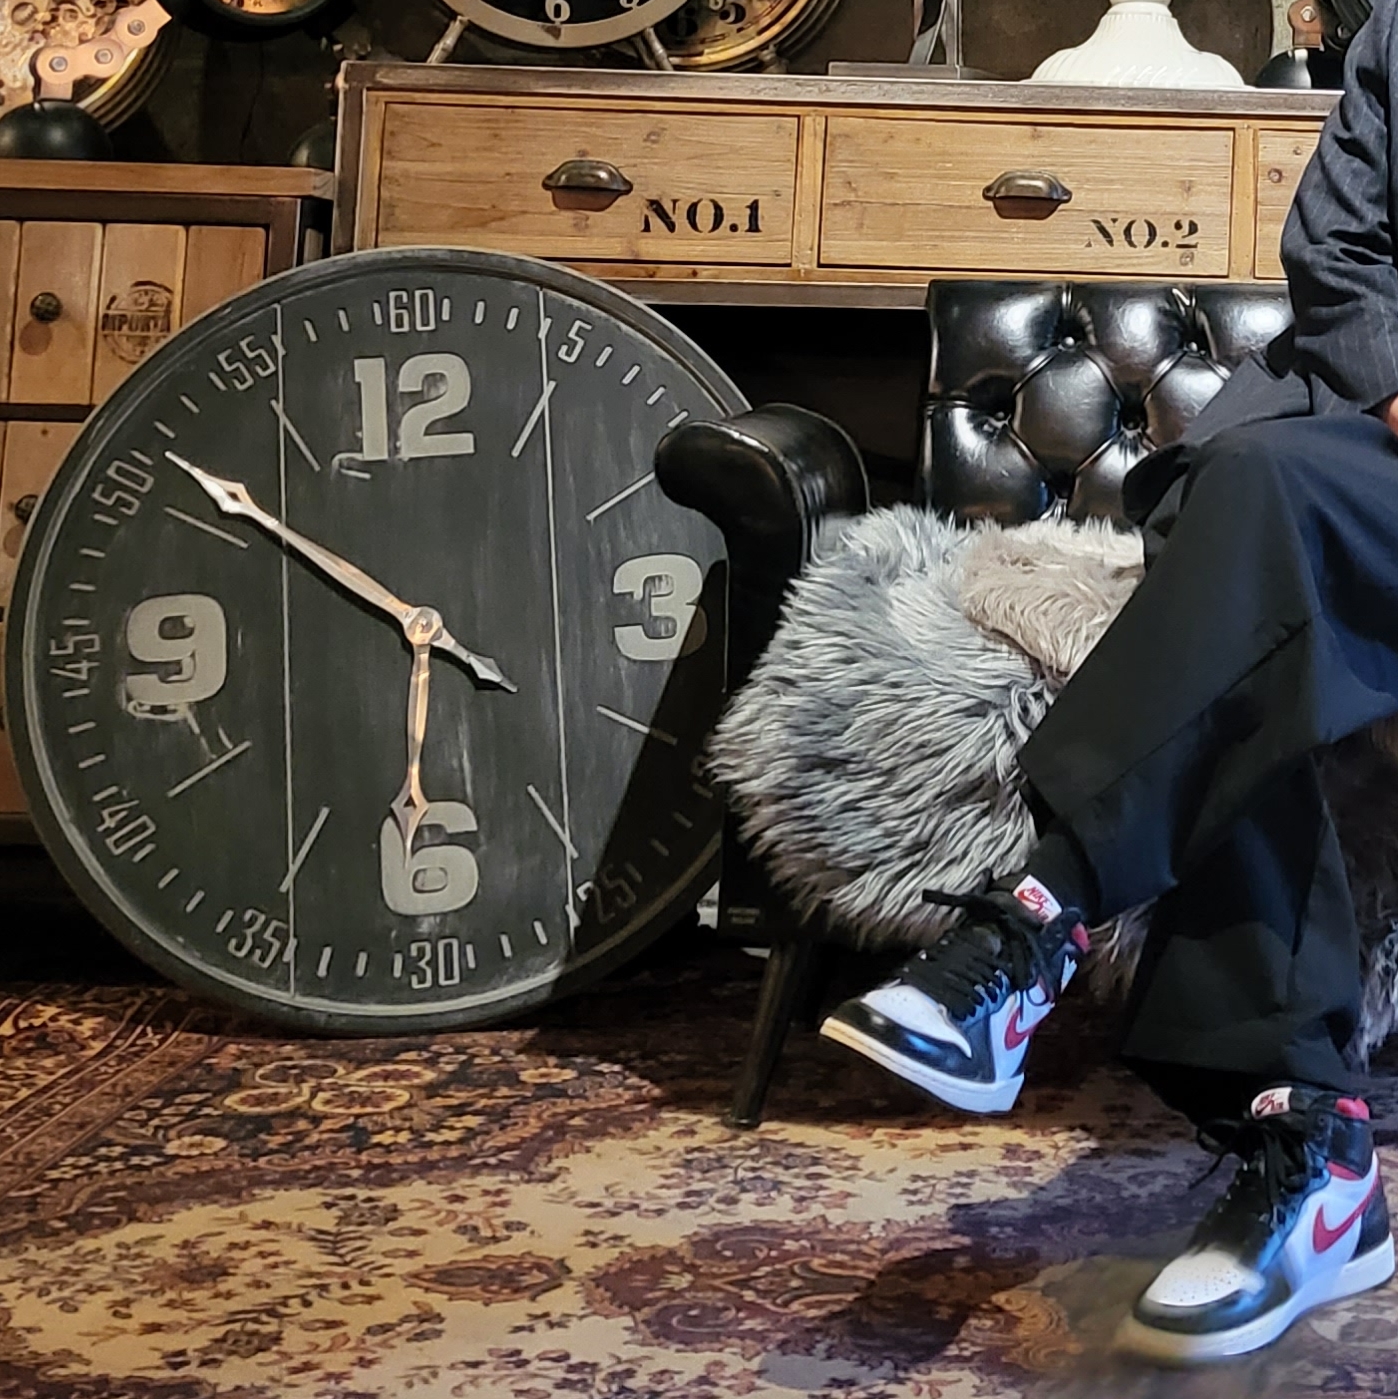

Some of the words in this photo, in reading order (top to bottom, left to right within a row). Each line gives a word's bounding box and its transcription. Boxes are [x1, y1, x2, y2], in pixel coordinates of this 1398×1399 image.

[640, 197, 763, 234] NO.1
[1085, 216, 1200, 249] NO.2
[388, 289, 437, 333] 60
[217, 335, 276, 392] 55
[557, 320, 593, 363] 5
[353, 352, 475, 462] 12
[91, 459, 154, 516] 50
[612, 553, 706, 662] 3
[49, 634, 99, 680] 45
[125, 593, 227, 702] 9
[97, 800, 157, 857] 40
[380, 800, 479, 916] 6
[228, 908, 289, 969] 35
[410, 937, 461, 989] 30
